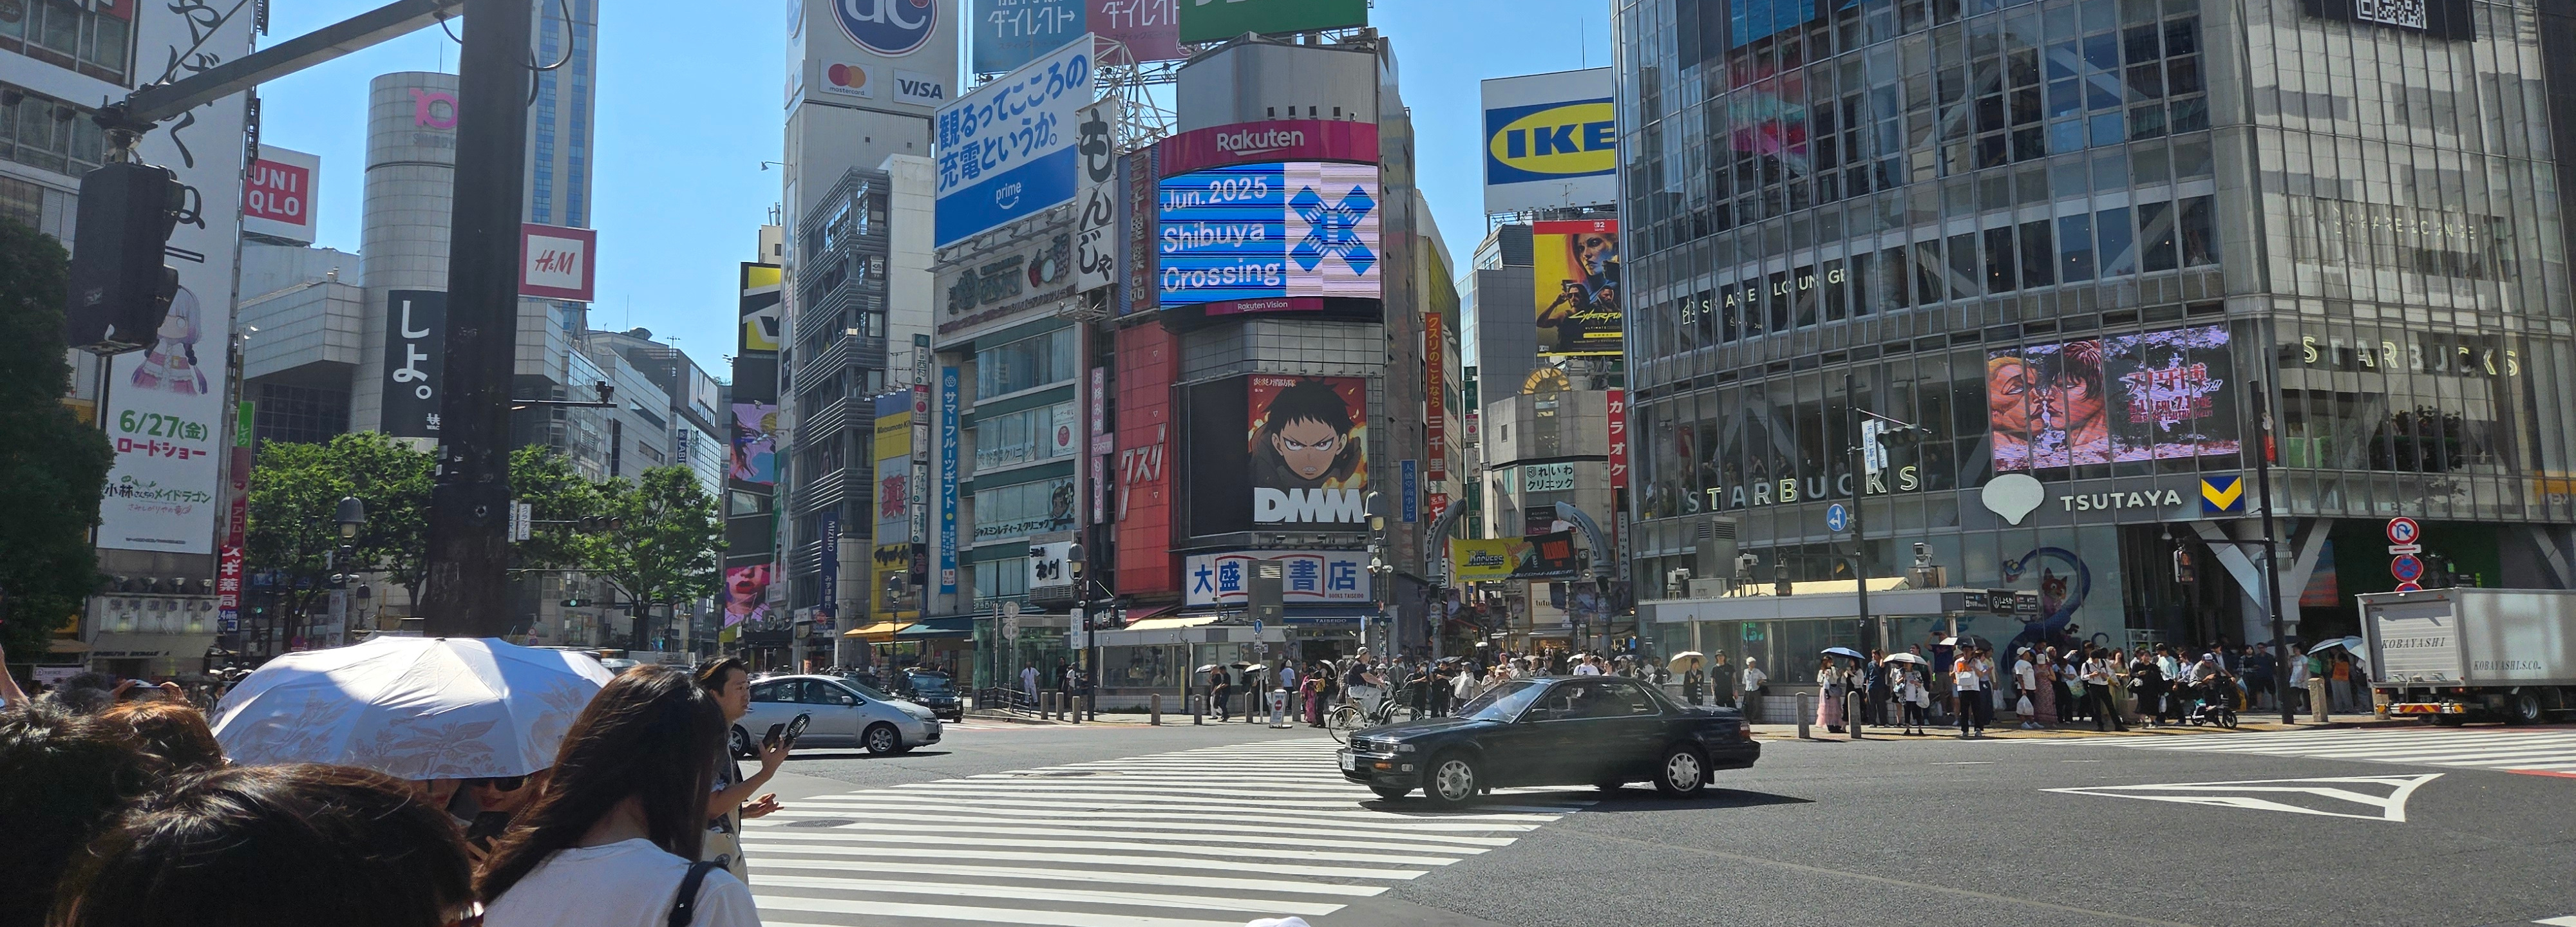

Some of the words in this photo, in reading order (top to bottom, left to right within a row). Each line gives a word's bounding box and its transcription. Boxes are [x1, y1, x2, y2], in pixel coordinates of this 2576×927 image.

[988, 6, 1075, 38] ダイレクト
[1102, 0, 1180, 29] ダイレクト
[829, 86, 865, 96] mastercard
[896, 79, 943, 100] VISA
[939, 54, 1088, 151] 観るってこころの
[409, 88, 458, 129] 10
[939, 111, 1057, 193] 充電というか。
[1217, 128, 1304, 153] Rakuten
[1506, 122, 1615, 160] IKE
[250, 165, 296, 193] UNI
[996, 181, 1022, 204] prime
[249, 190, 299, 217] QLO
[1079, 108, 1113, 281] もんじゃ
[1163, 189, 1206, 212] Jun.
[1208, 176, 1268, 205] 2025
[1163, 221, 1265, 254] Shibuya
[535, 249, 574, 276] H&M
[1163, 258, 1281, 294] Crossing
[1237, 302, 1266, 311] Rakuten
[1266, 301, 1288, 310] Vision
[392, 300, 433, 400] しよ。
[1428, 316, 1441, 407] クスリのことなら
[783, 360, 790, 379] 7F
[1253, 377, 1296, 388] 炎炎ノ消防隊
[119, 409, 208, 442] 6/27(金)
[239, 424, 249, 445] レイク
[876, 424, 903, 435] Matsumoto
[117, 437, 207, 460] ロードショー
[943, 391, 956, 509] サマーフルーツギフト
[977, 444, 1035, 465] 渋谷クリニック
[1428, 415, 1444, 473] 三千里
[1609, 400, 1627, 489] カラオケ
[1119, 422, 1167, 521] クスリ
[1527, 478, 1574, 491] クリニック
[1538, 465, 1573, 477] れいわ
[104, 483, 212, 503] 小林さんちのメイドラゴン
[1685, 465, 1919, 513] STARBUCKS
[2060, 489, 2183, 512] TSUTAYA
[232, 506, 243, 534] アコム
[1253, 487, 1366, 524] DMM
[827, 520, 835, 552] MIZUHO
[974, 519, 1049, 538] ジャスミンレディースクリニック
[220, 546, 242, 609] スギ薬局
[1193, 559, 1357, 595] 大盛書店
[2382, 637, 2446, 650] KOBAYASHI
